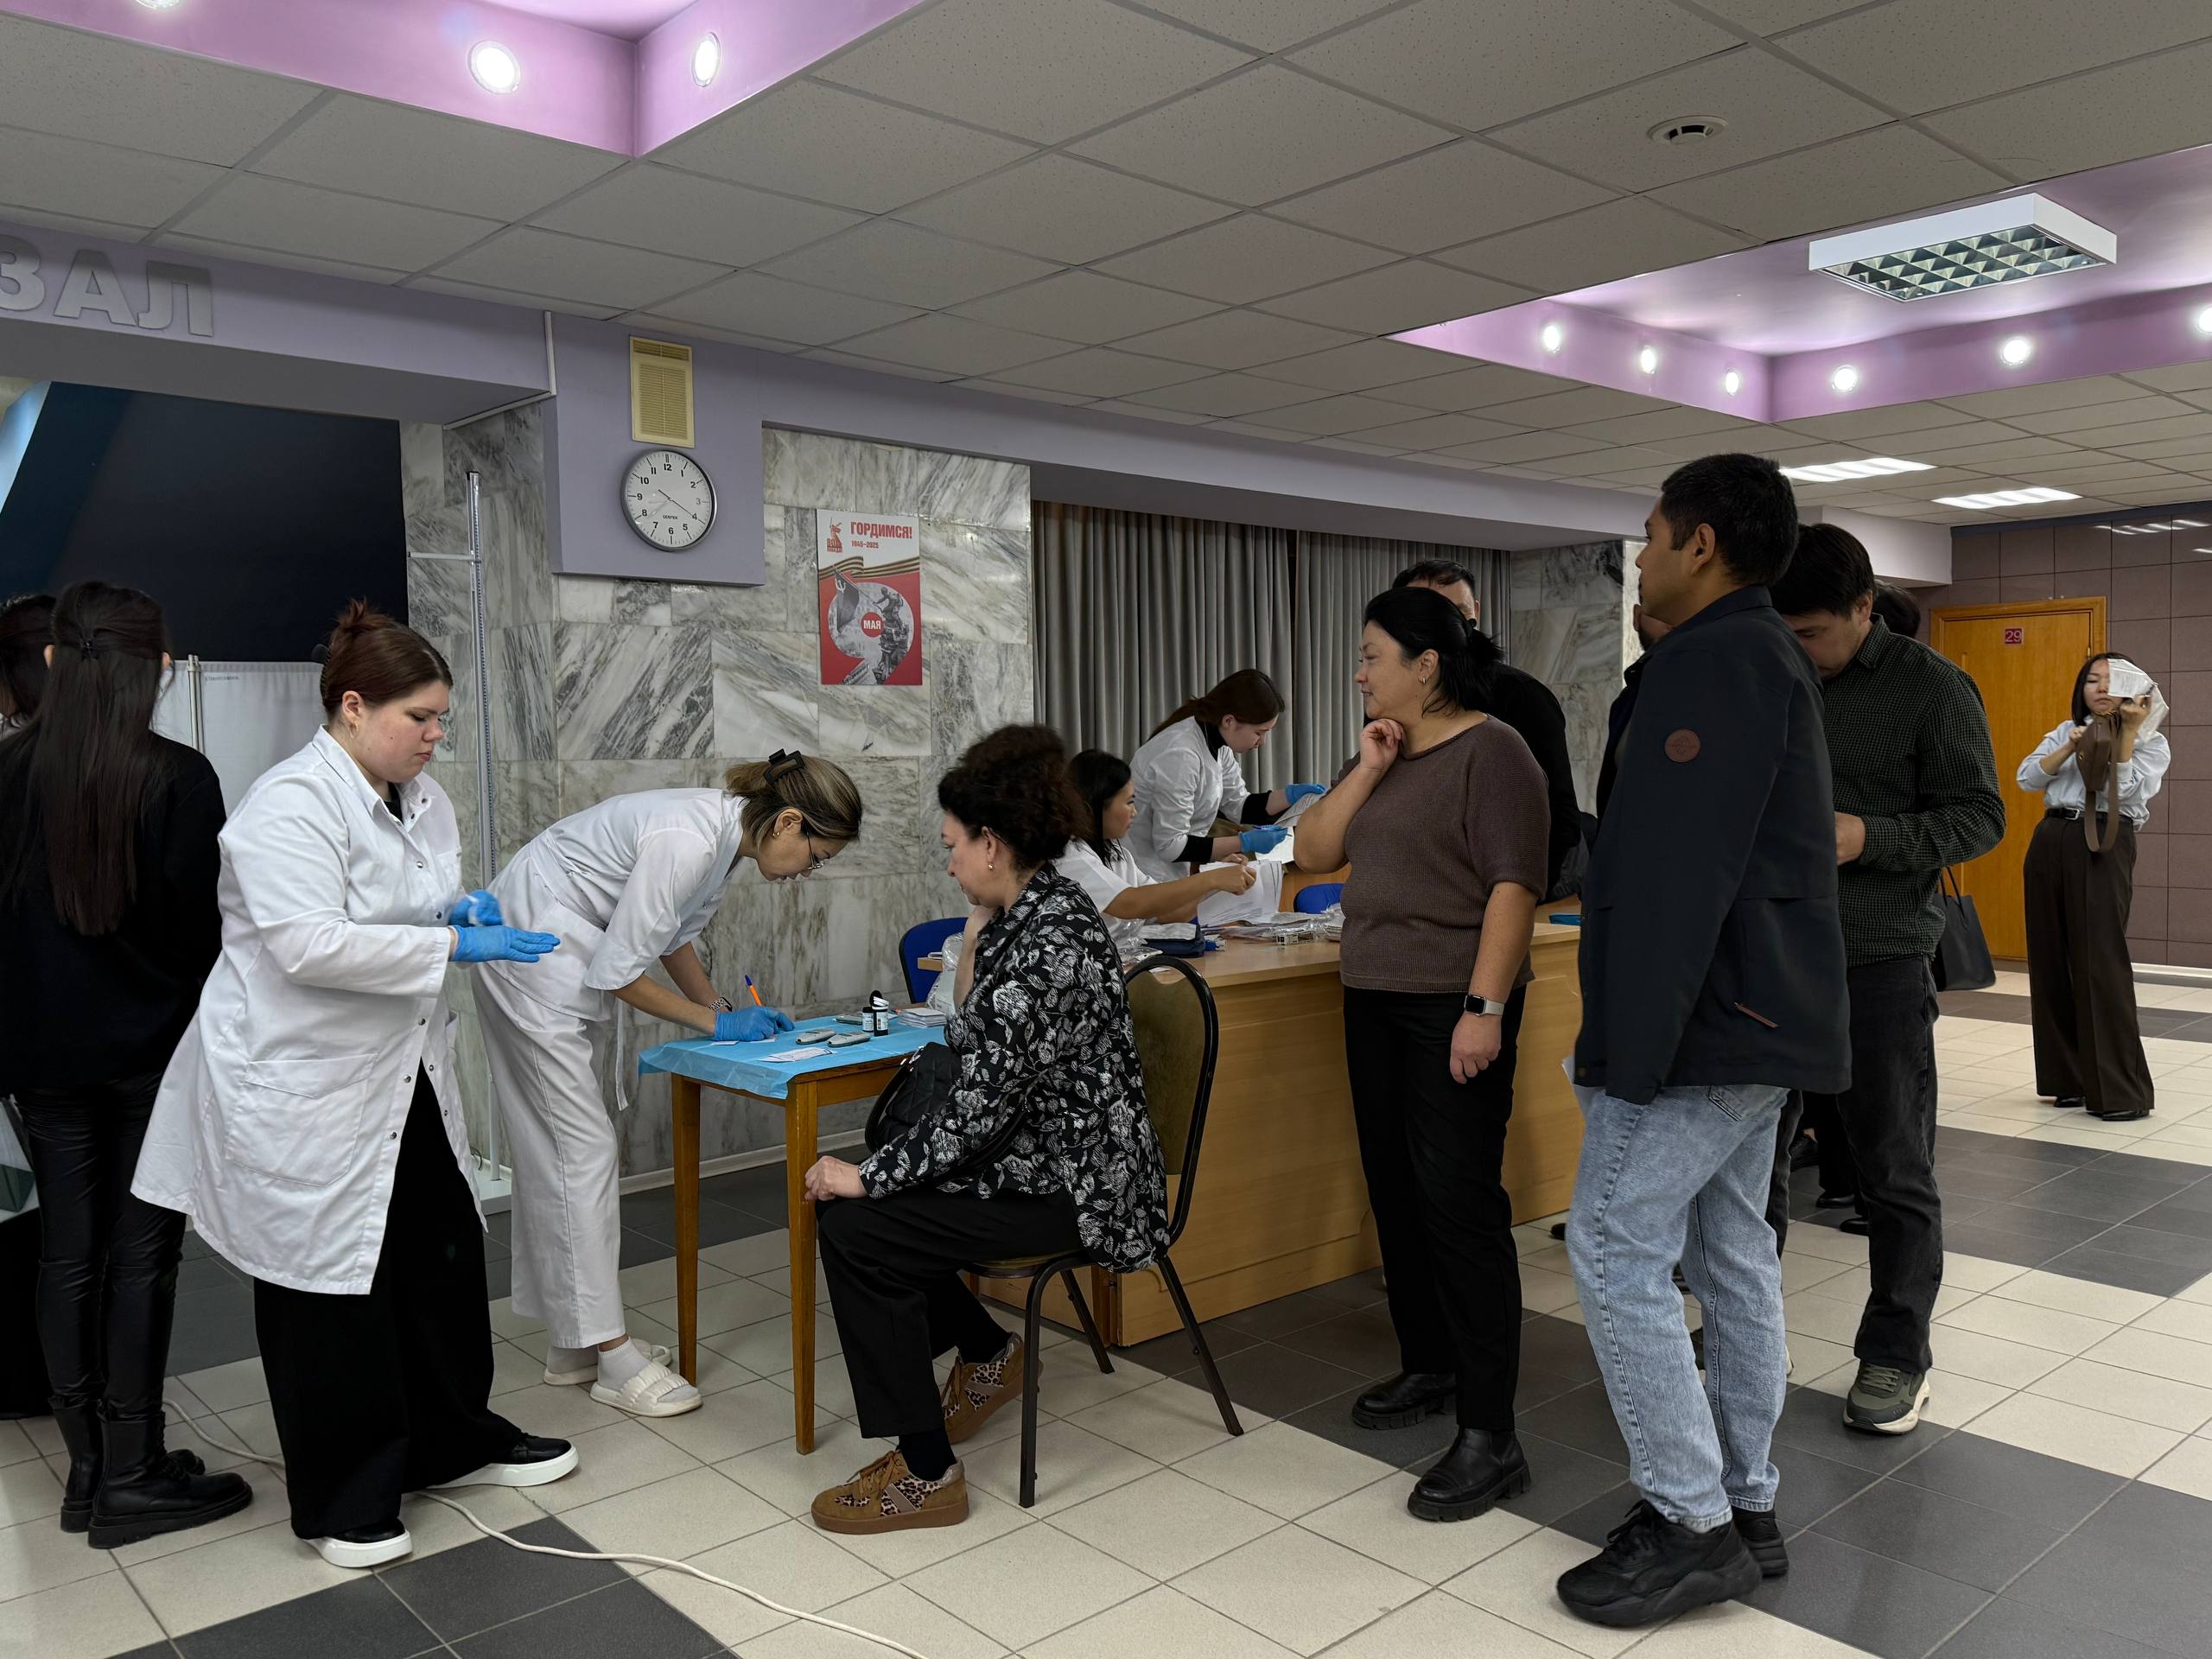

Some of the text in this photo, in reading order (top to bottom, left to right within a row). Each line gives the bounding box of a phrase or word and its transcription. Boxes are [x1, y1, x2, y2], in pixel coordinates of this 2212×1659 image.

[0, 234, 213, 337] ЗАЛ
[664, 463, 672, 472] 12
[640, 476, 650, 485] 10
[850, 521, 912, 539] ГОРДИМСЯ!
[863, 620, 881, 630] МАЯ
[2005, 630, 2021, 643] 29
